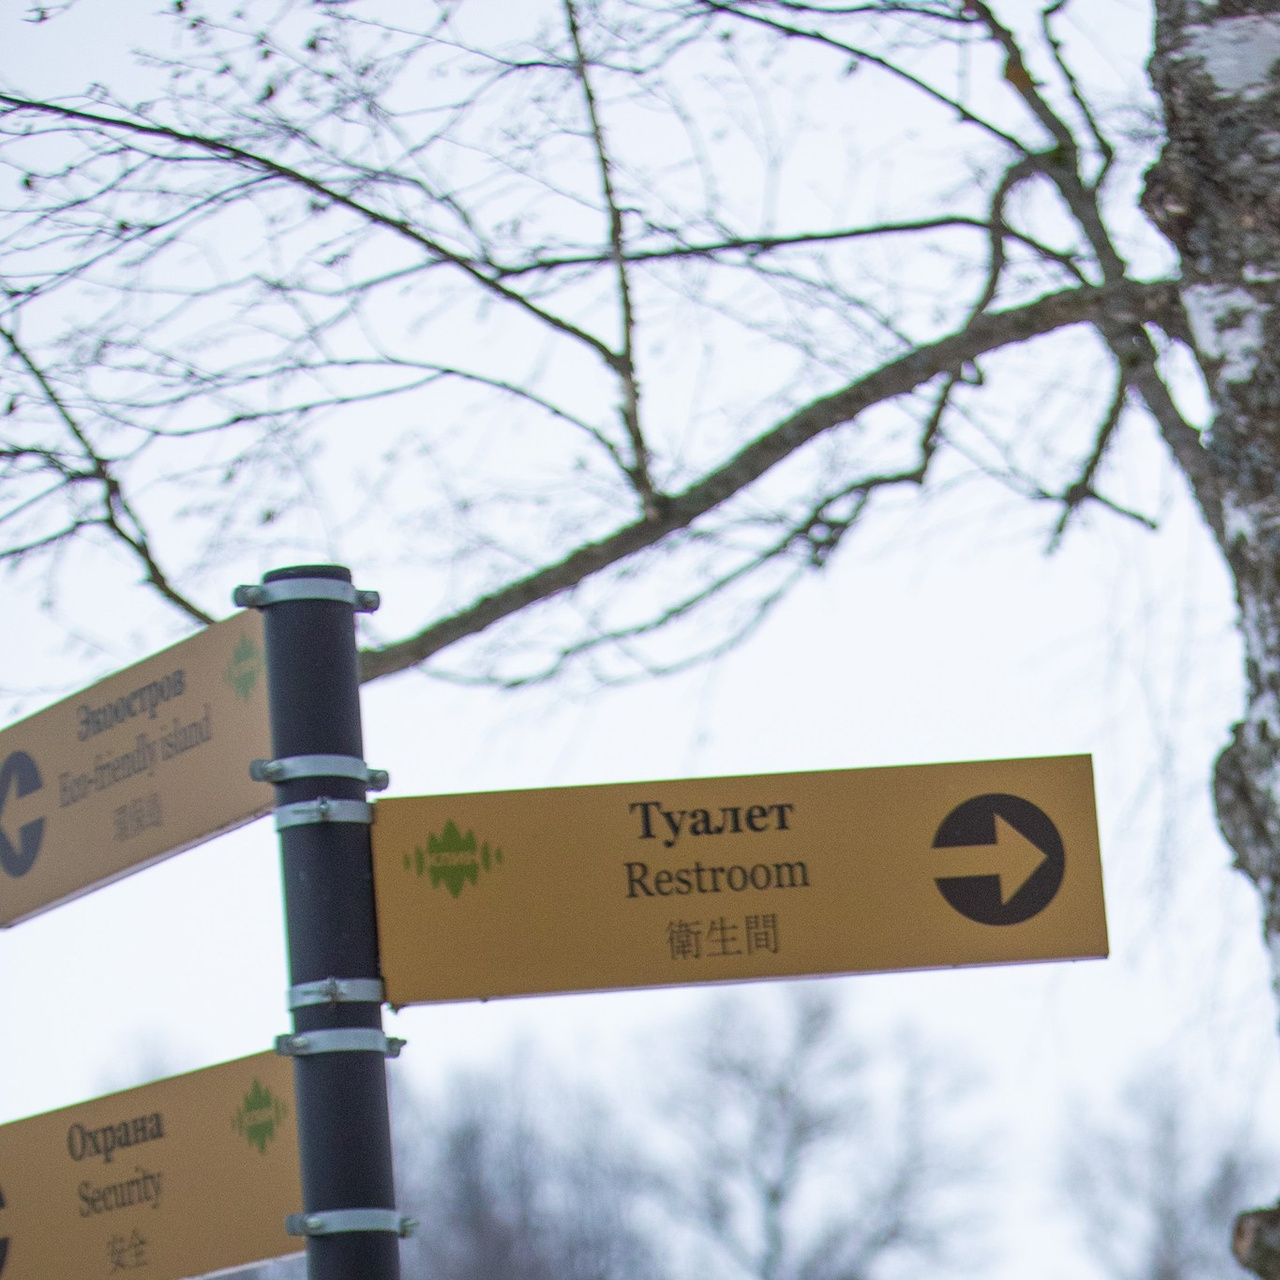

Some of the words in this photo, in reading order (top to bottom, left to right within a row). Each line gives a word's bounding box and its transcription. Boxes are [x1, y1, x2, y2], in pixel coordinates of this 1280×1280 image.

[628, 801, 796, 848] Туалет
[623, 860, 811, 898] Restroom
[667, 913, 780, 960] 衛生間
[66, 1111, 164, 1163] Охрана
[78, 1165, 163, 1218] Security
